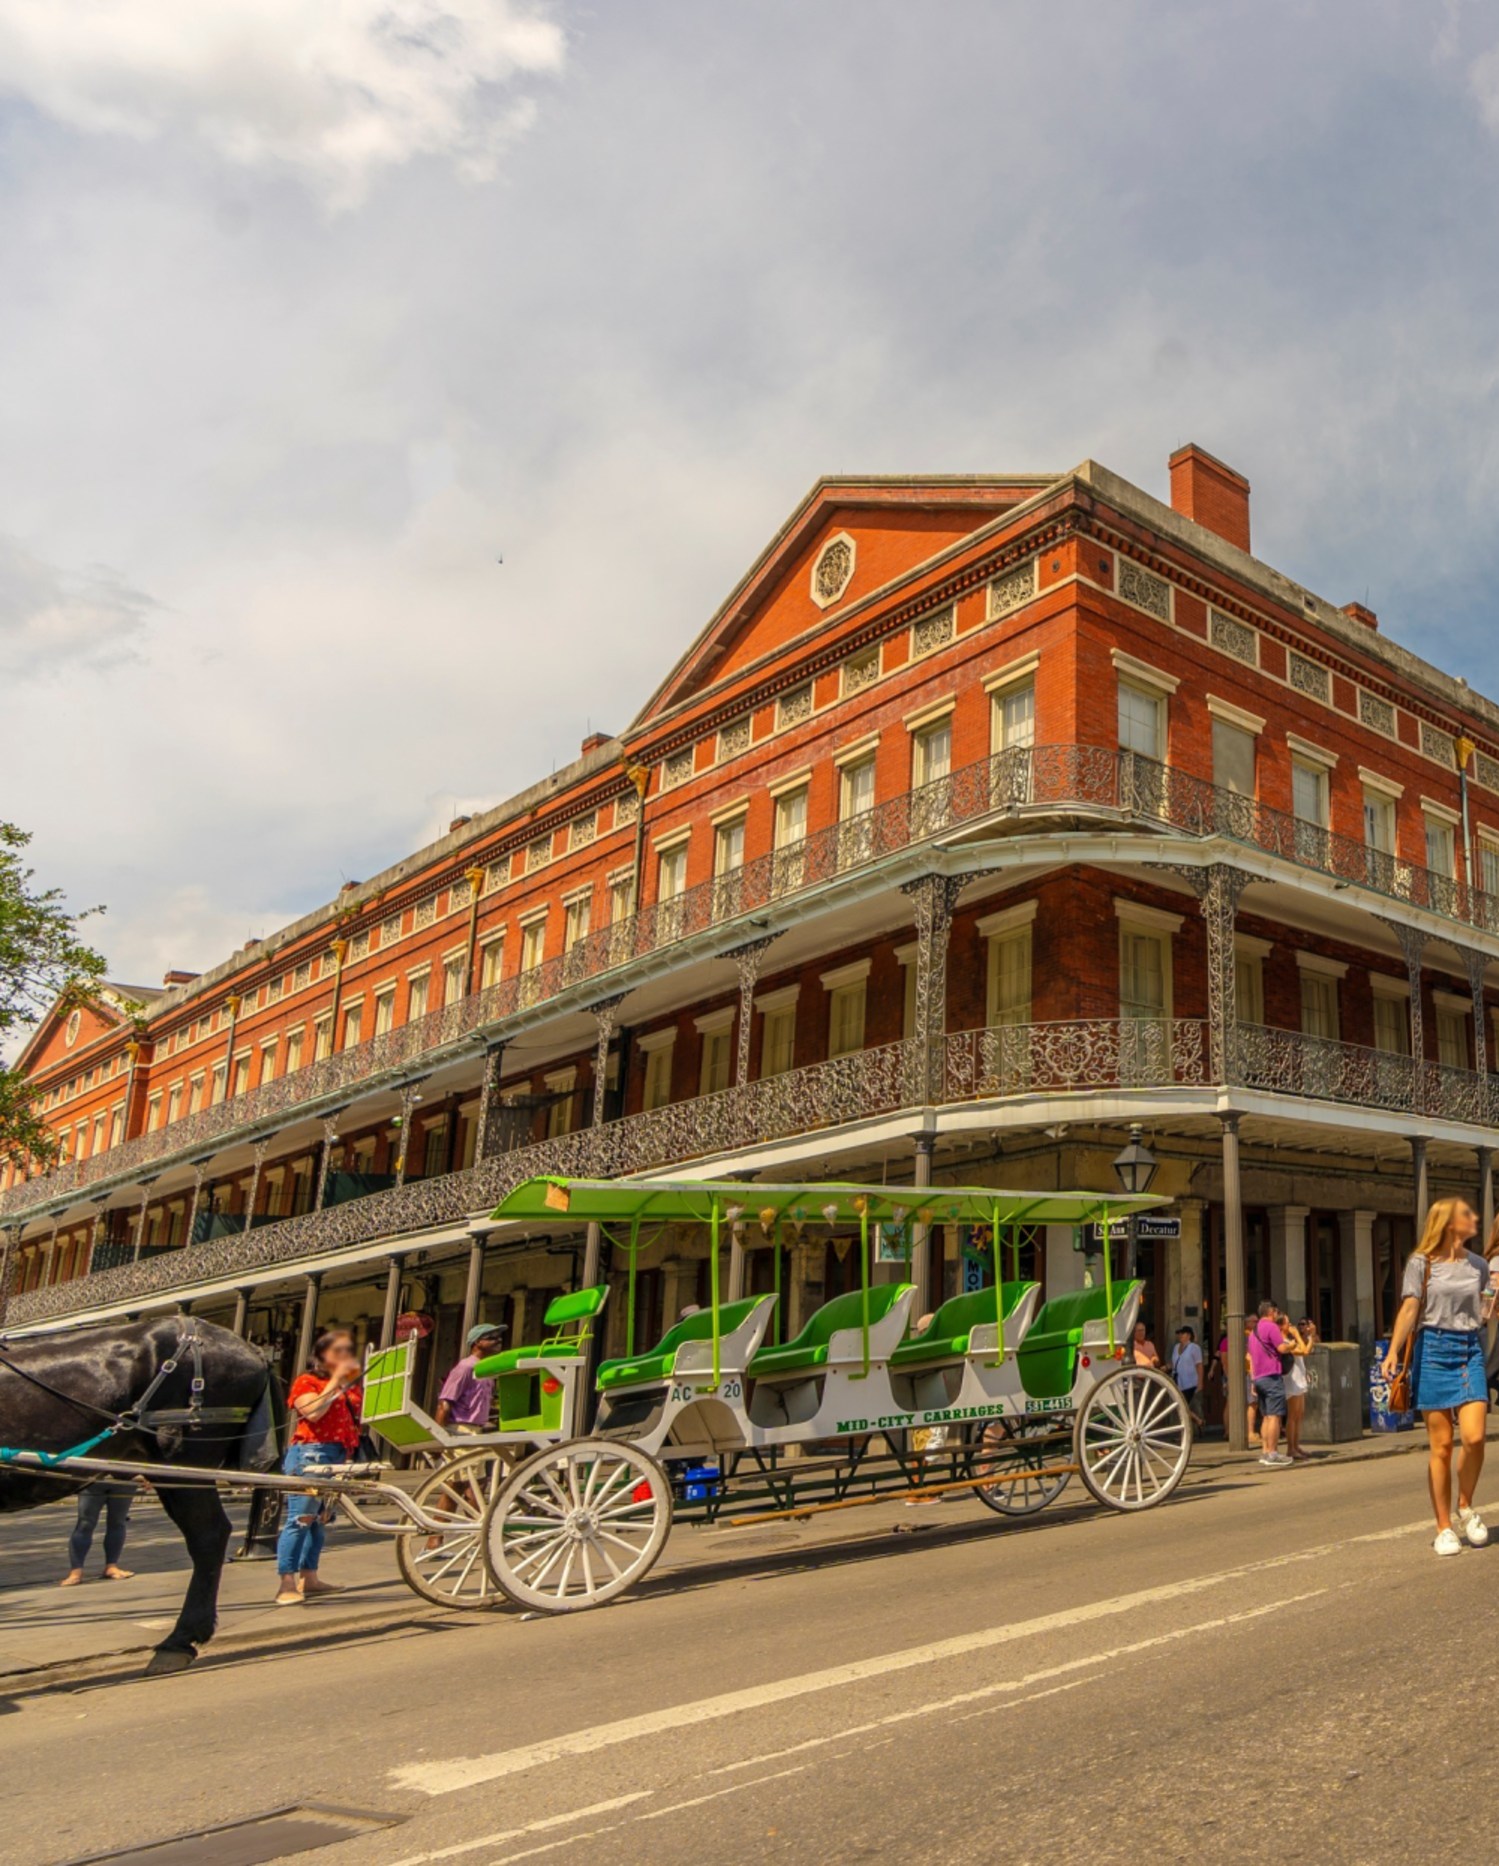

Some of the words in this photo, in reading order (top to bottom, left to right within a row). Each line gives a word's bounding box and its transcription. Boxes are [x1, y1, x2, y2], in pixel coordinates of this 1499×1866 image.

[1110, 1224, 1126, 1235] Ann
[1141, 1222, 1178, 1235] Decatur
[671, 1386, 692, 1401] AC
[723, 1383, 741, 1399] 20
[836, 1413, 916, 1434] MID-CITY
[923, 1403, 1005, 1424] CARRIAGES
